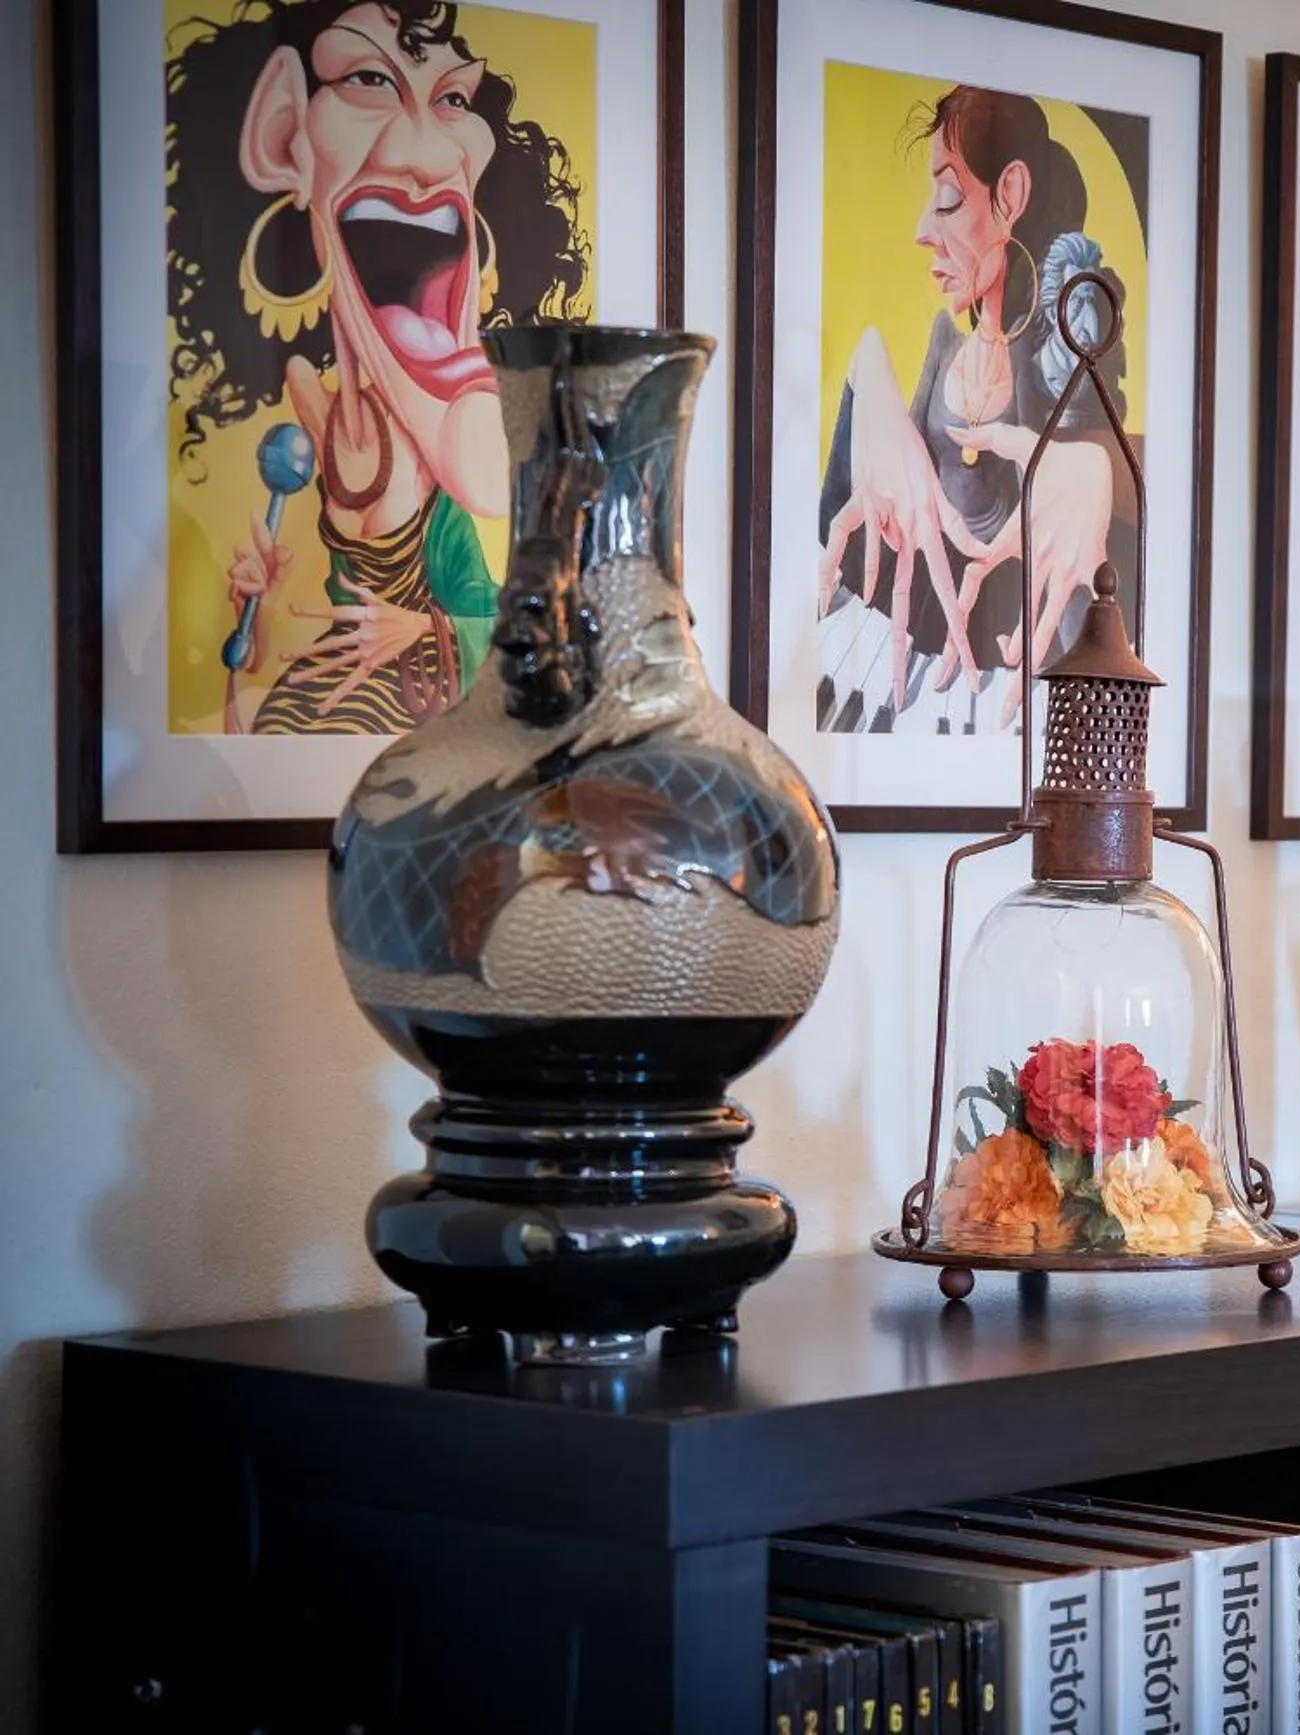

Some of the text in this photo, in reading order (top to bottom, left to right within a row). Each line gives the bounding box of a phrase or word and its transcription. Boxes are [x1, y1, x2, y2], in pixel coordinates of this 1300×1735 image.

[1223, 1561, 1261, 1735] História
[918, 1686, 931, 1717] 5
[947, 1679, 960, 1709] 4
[983, 1682, 995, 1712] 8
[835, 1705, 846, 1733] 1
[862, 1699, 876, 1730] 7
[890, 1703, 903, 1734] 6
